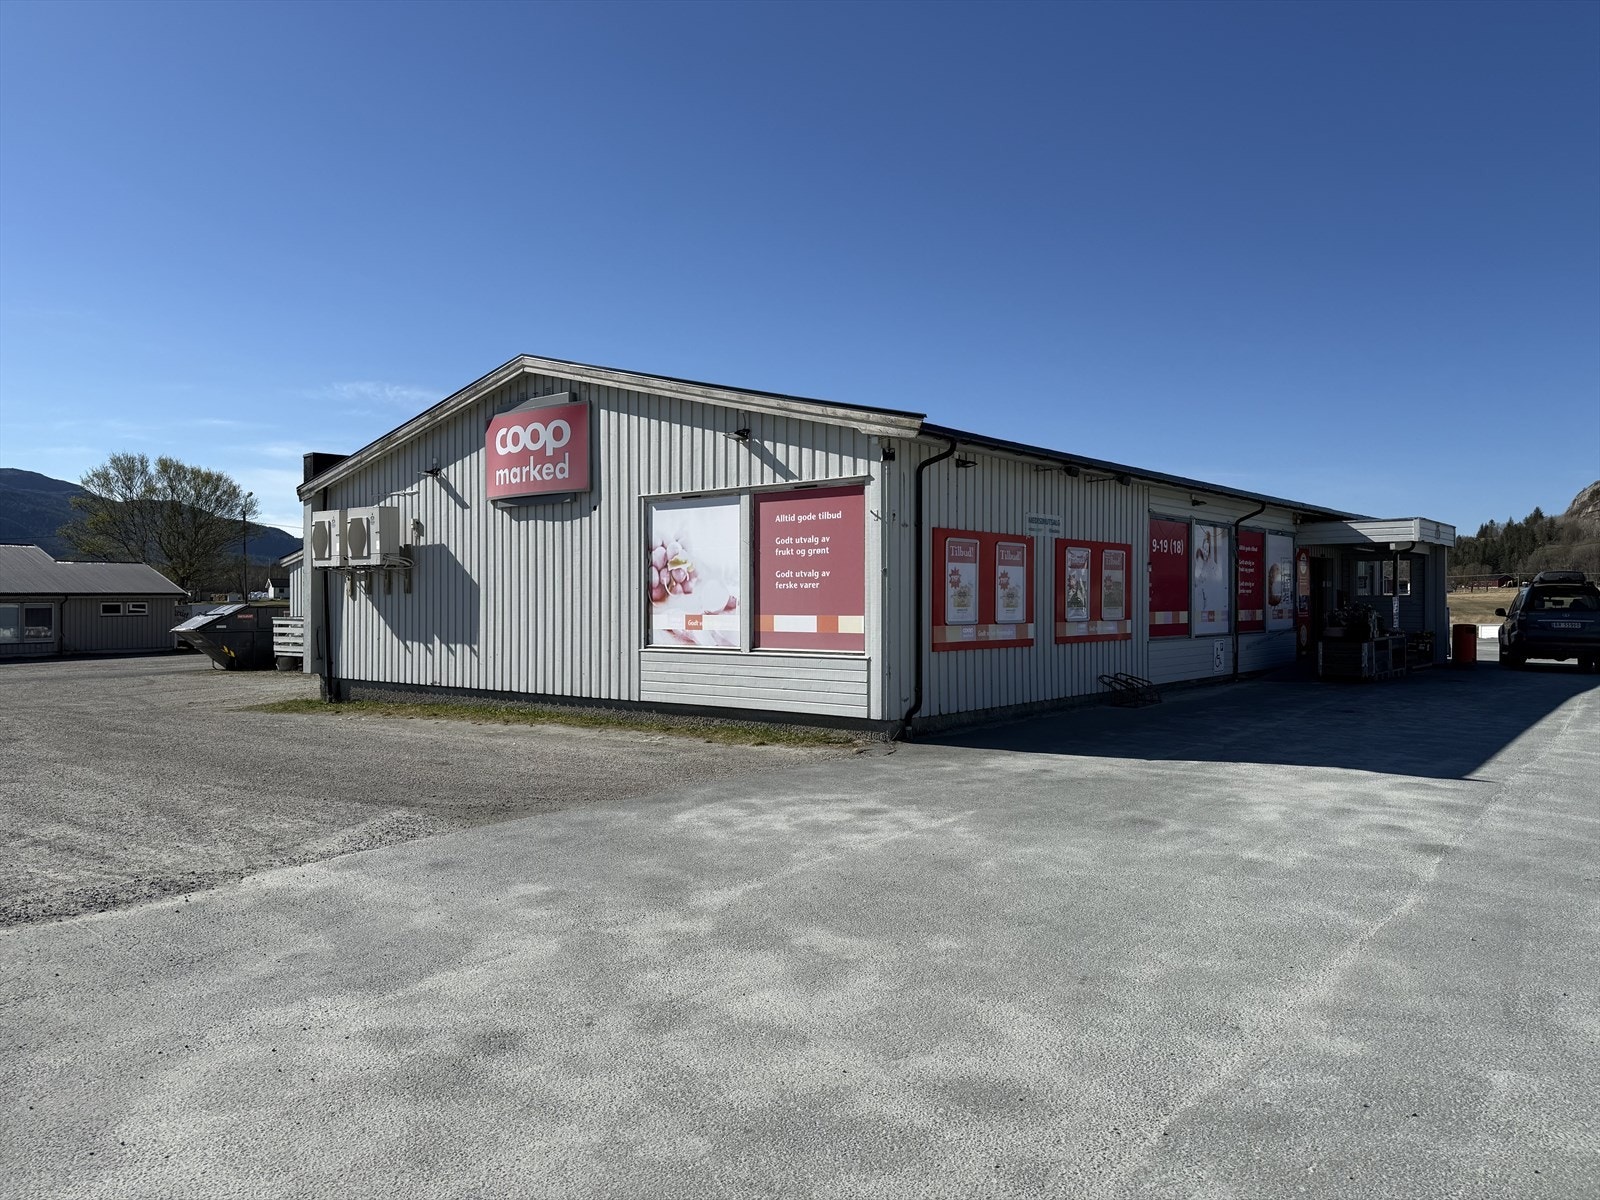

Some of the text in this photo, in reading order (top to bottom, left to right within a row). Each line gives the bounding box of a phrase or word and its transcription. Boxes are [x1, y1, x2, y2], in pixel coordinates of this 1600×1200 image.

[495, 419, 571, 456] coop
[495, 452, 569, 486] marked
[775, 510, 842, 524] Alltid gode tilbud
[775, 536, 793, 545] Godt
[795, 535, 819, 545] utvalg
[775, 546, 830, 557] frukt og grønt
[949, 545, 974, 558] Tilbud!
[1152, 538, 1184, 556] 9-19 (18)
[775, 569, 793, 578] Godt
[795, 569, 819, 579] utvalg
[775, 581, 820, 589] ferske varer
